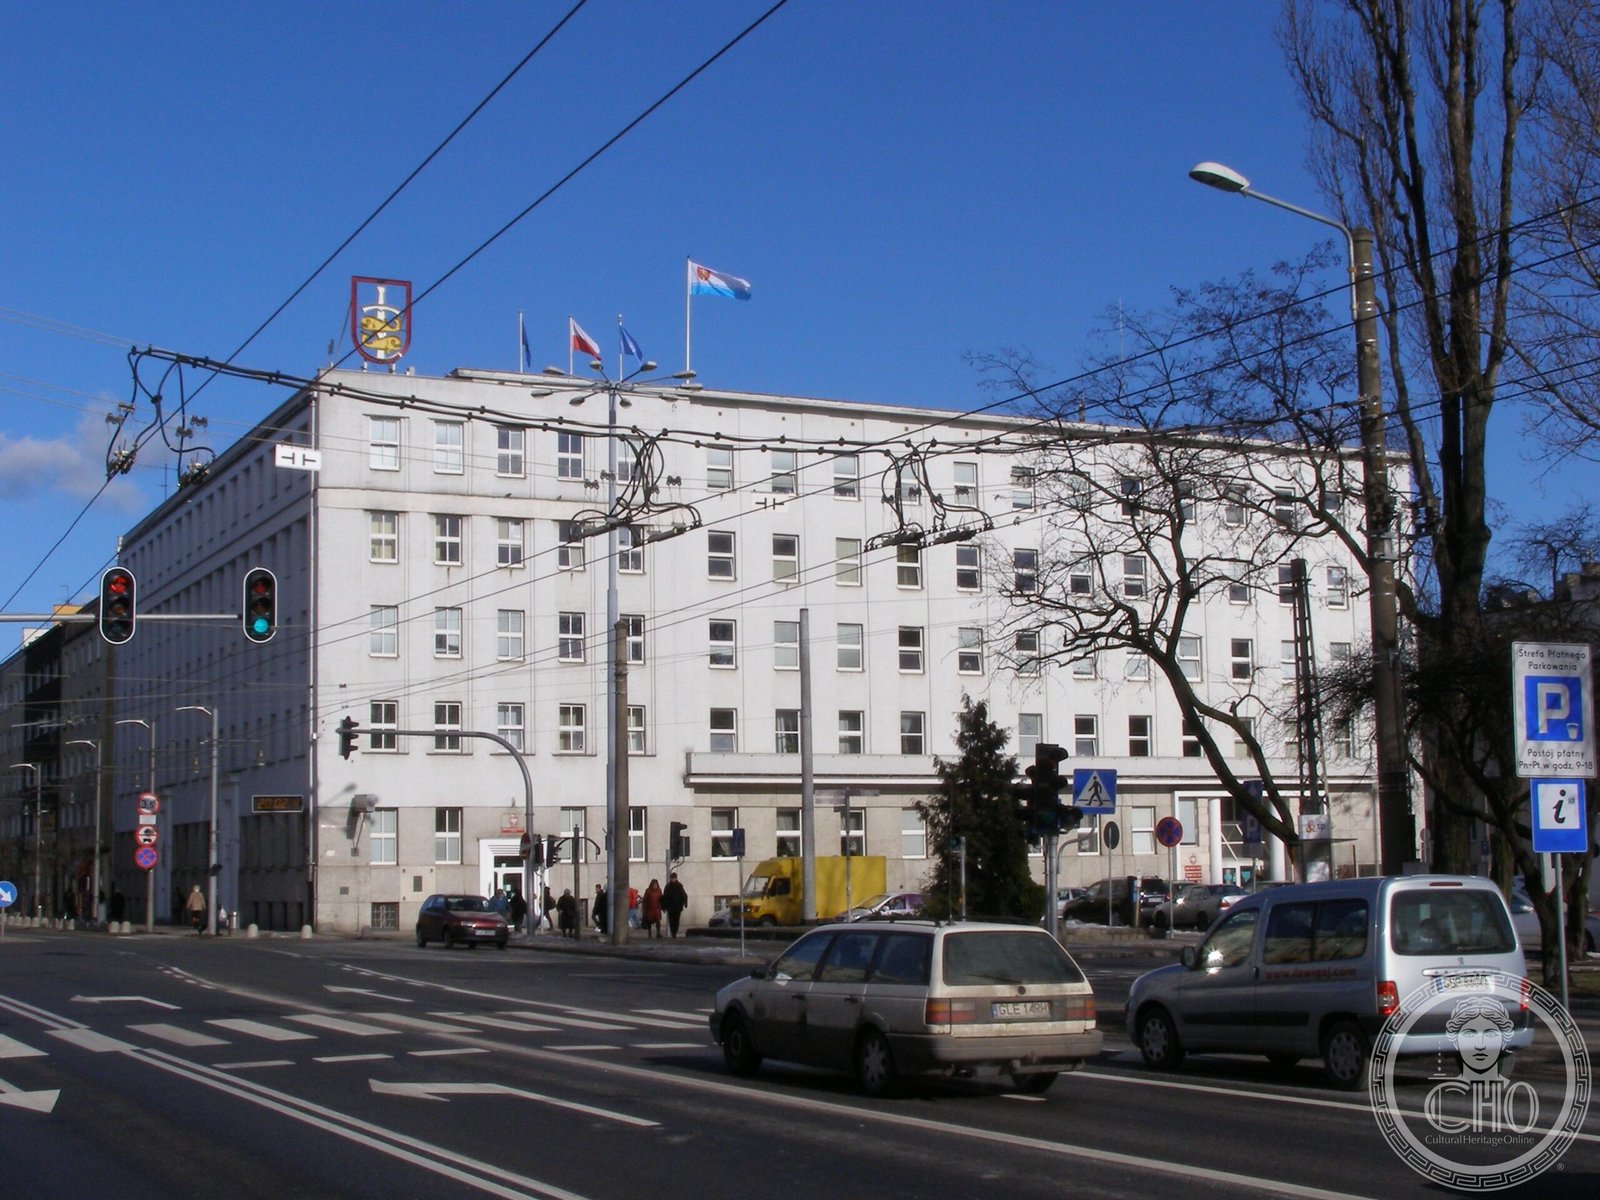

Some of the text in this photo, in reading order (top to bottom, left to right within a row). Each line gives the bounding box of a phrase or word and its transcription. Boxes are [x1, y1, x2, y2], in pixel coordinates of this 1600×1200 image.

[1518, 648, 1586, 661] Strefa Płatnego
[1528, 661, 1577, 671] Parkowania
[1536, 682, 1570, 734] P
[1527, 748, 1554, 759] Postój
[1518, 760, 1540, 769] Pn-Pt
[1575, 761, 1593, 770] 9-18
[999, 1003, 1021, 1016] GLE
